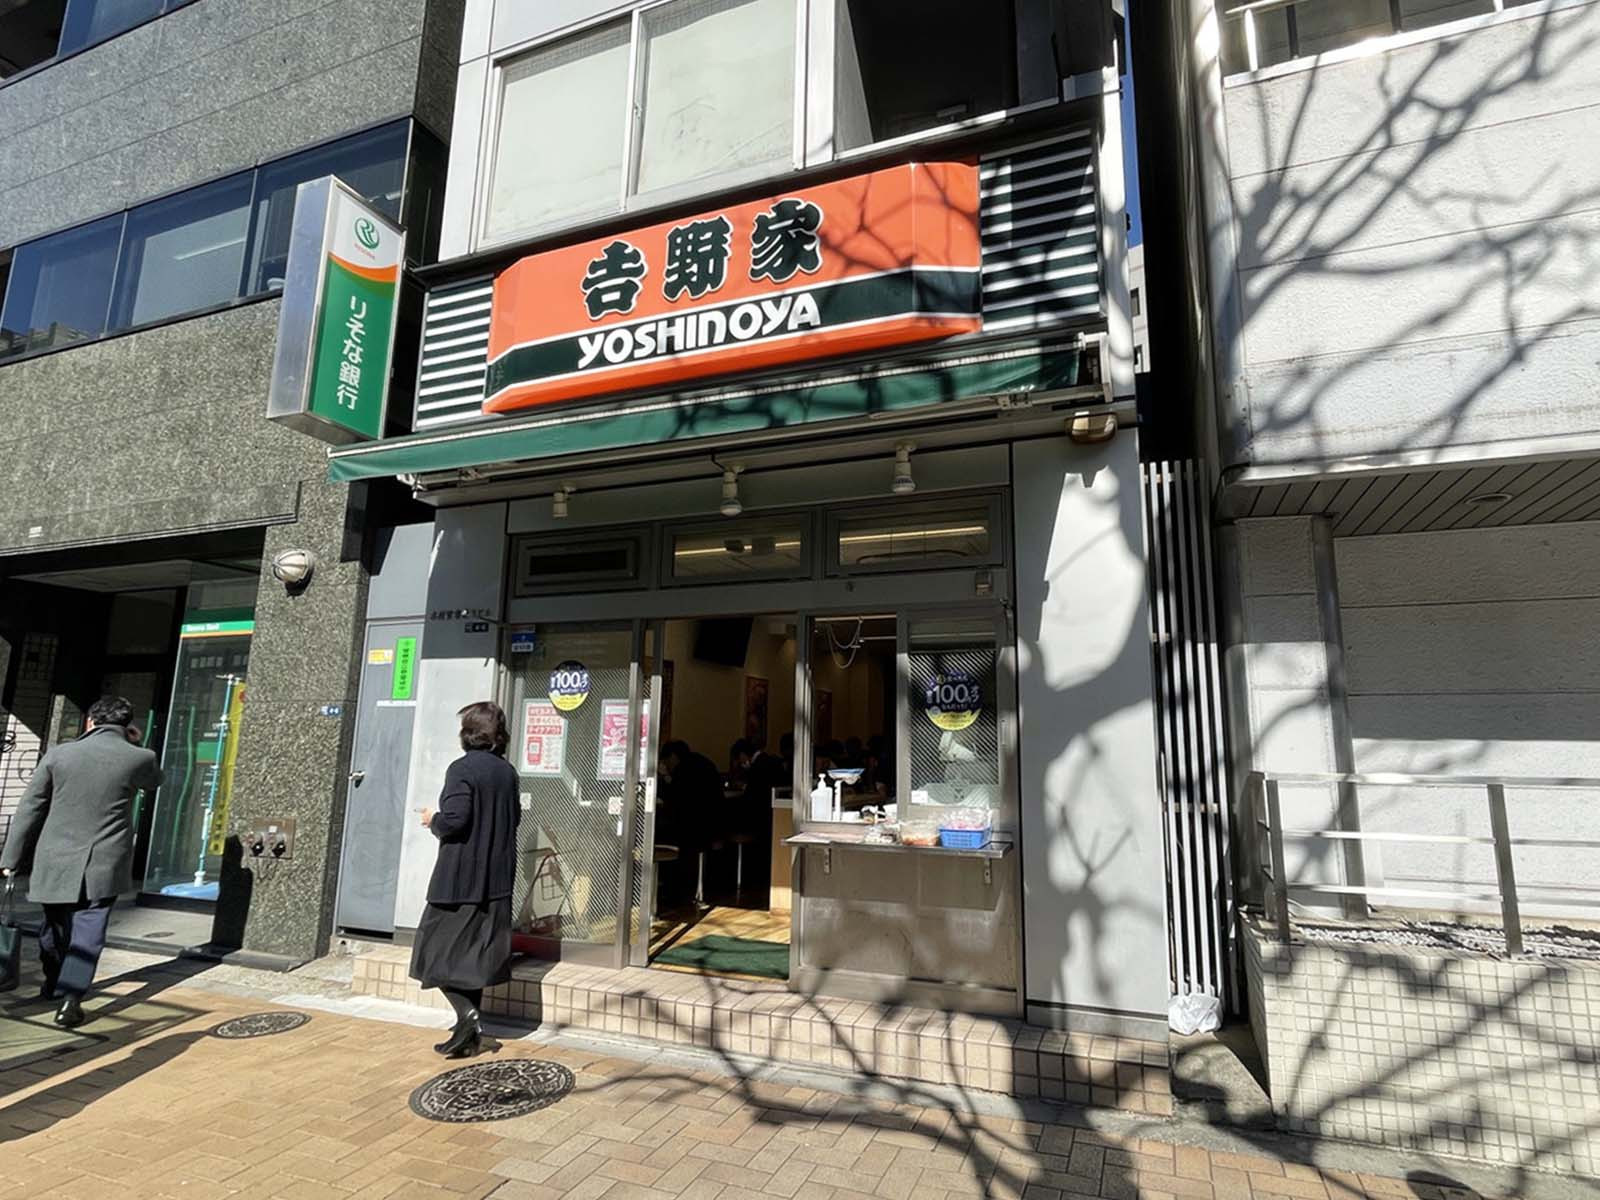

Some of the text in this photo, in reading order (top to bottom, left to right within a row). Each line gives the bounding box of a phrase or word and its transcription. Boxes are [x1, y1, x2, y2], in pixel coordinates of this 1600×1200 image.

[337, 296, 368, 410] りそな銀行
